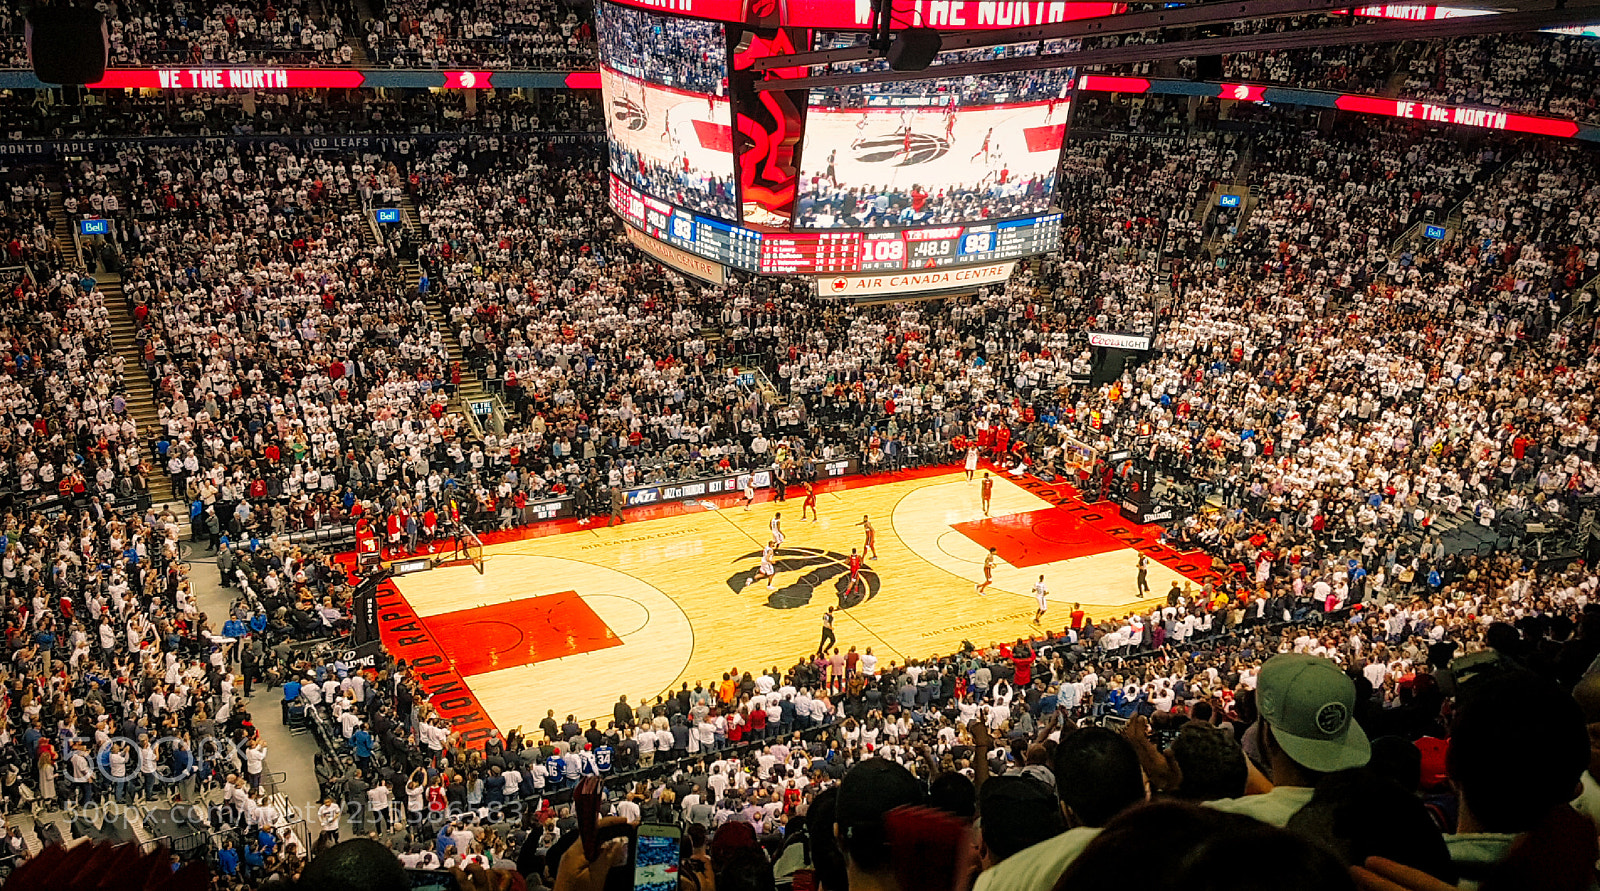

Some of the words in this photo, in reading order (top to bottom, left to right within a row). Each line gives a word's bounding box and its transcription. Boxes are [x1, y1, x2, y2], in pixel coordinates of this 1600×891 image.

[158, 70, 182, 88] WE
[188, 70, 224, 88] THE
[229, 70, 288, 88] NORTH
[1422, 103, 1449, 122] THE
[1453, 107, 1507, 130] NORTH
[313, 138, 328, 147] GO
[334, 137, 369, 147] LEAFS
[1222, 196, 1236, 206] Bell
[380, 211, 395, 220] Bell
[86, 222, 104, 232] Bell
[1427, 227, 1442, 238] Bell
[914, 240, 950, 257] :48.9
[964, 233, 990, 252] 93
[862, 241, 904, 261] 103
[676, 253, 714, 276] CENTRE
[856, 278, 883, 289] AIR
[890, 272, 949, 287] CANADA
[955, 265, 1005, 281] CENTRE
[1091, 334, 1120, 346] Coors
[1120, 340, 1147, 349] LIGHT
[663, 487, 676, 500] JAZZ
[1143, 509, 1172, 523] SPALDING
[604, 535, 655, 546] CANADA
[921, 630, 940, 638] AIR
[943, 620, 993, 633] CANADA
[598, 755, 611, 765] 34
[548, 765, 558, 776] 16
